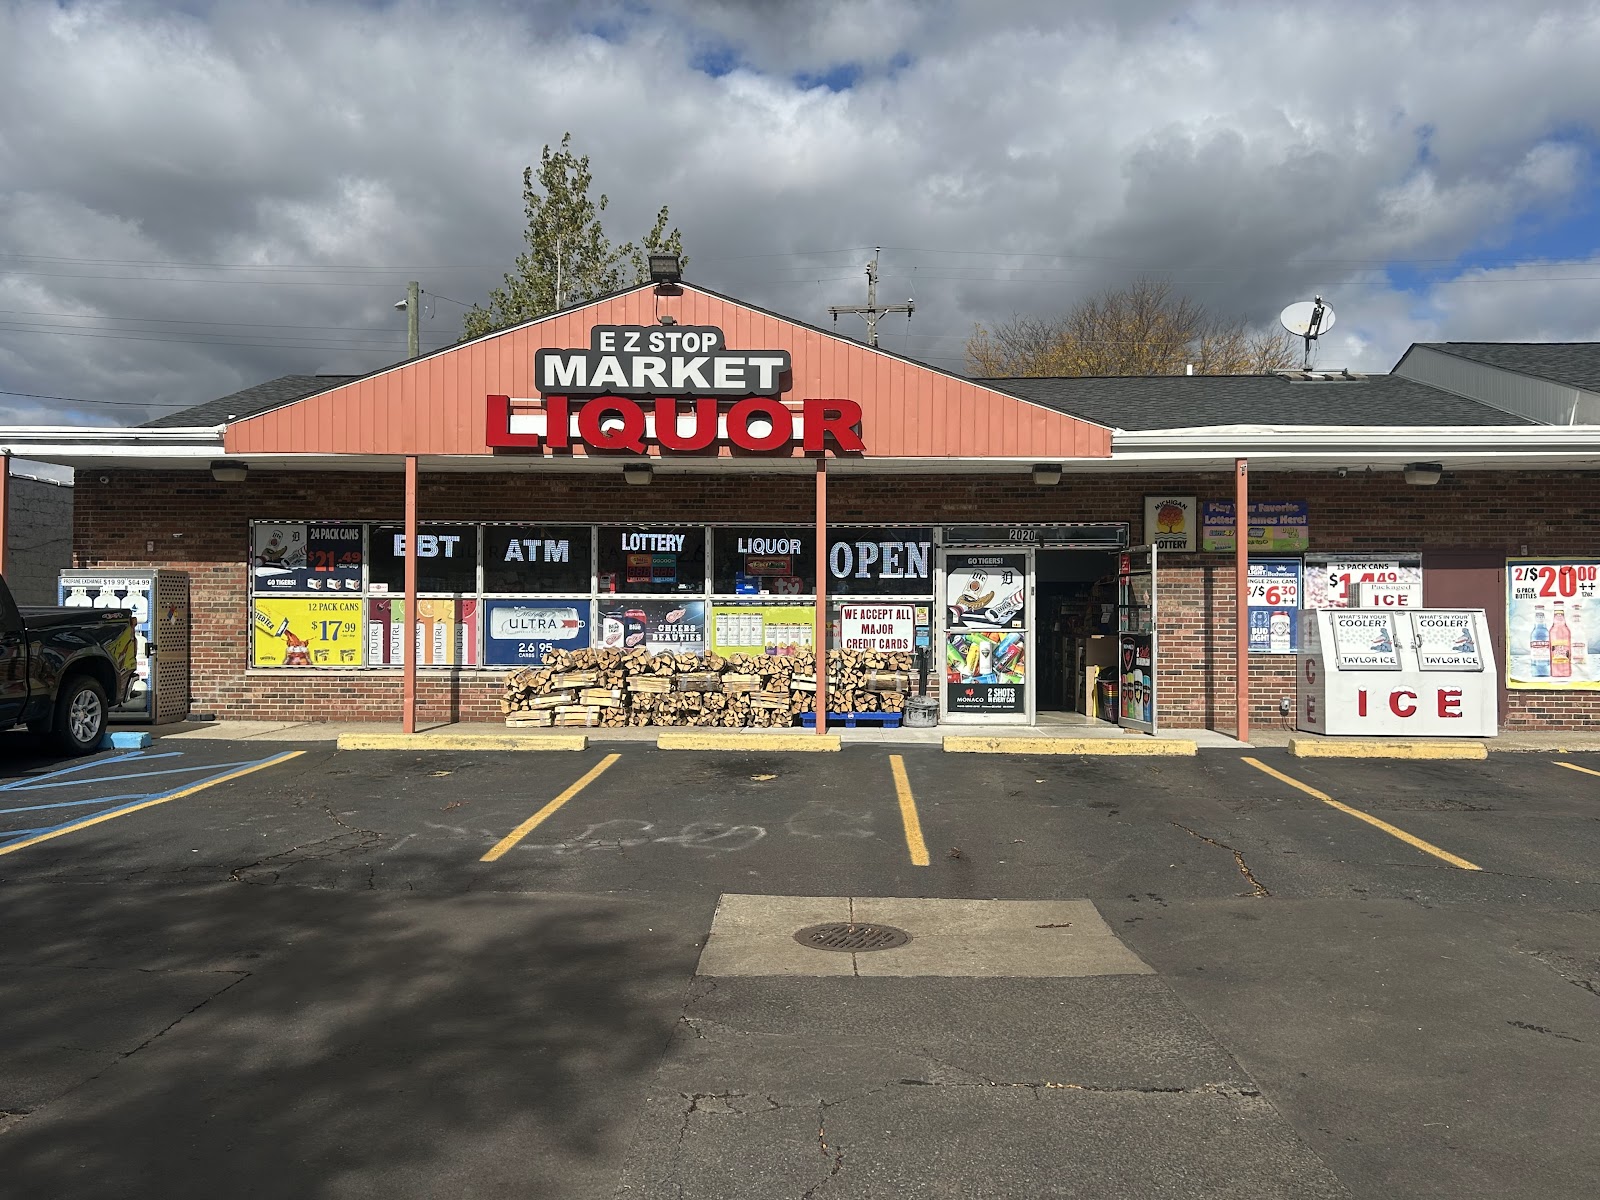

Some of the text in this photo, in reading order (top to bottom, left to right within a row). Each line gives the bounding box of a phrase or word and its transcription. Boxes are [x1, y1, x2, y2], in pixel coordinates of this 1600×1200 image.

[600, 332, 717, 353] E Z STOP
[544, 356, 783, 389] MARKET
[487, 395, 866, 454] LIQUOR
[1155, 500, 1187, 510] MICHIGAN
[1209, 503, 1230, 513] Play
[1259, 503, 1299, 512] Favorite
[1205, 515, 1235, 524] Lotter
[1280, 515, 1306, 524] Here!
[310, 528, 359, 540] 24 PACK CANS
[1011, 530, 1035, 540] 2020
[394, 534, 460, 558] EBT
[622, 533, 685, 551] LOTTERY
[738, 538, 801, 555] LIQUOR
[1156, 540, 1187, 550] LOTTERY
[504, 539, 569, 562] ATM
[830, 542, 931, 578] OPEN
[1374, 595, 1408, 606] ICE
[308, 603, 359, 611] 12 PACK CANS
[844, 609, 857, 619] WE
[860, 609, 893, 619] ACCEPT
[896, 609, 910, 619] ALL
[510, 619, 556, 628] ULTRA
[862, 624, 893, 634] MAJOR
[519, 643, 552, 652] 2.6 95
[846, 639, 908, 649] CREDIT CARDS
[988, 688, 1015, 697] 2 SHOTS
[1357, 686, 1462, 718] ICE
